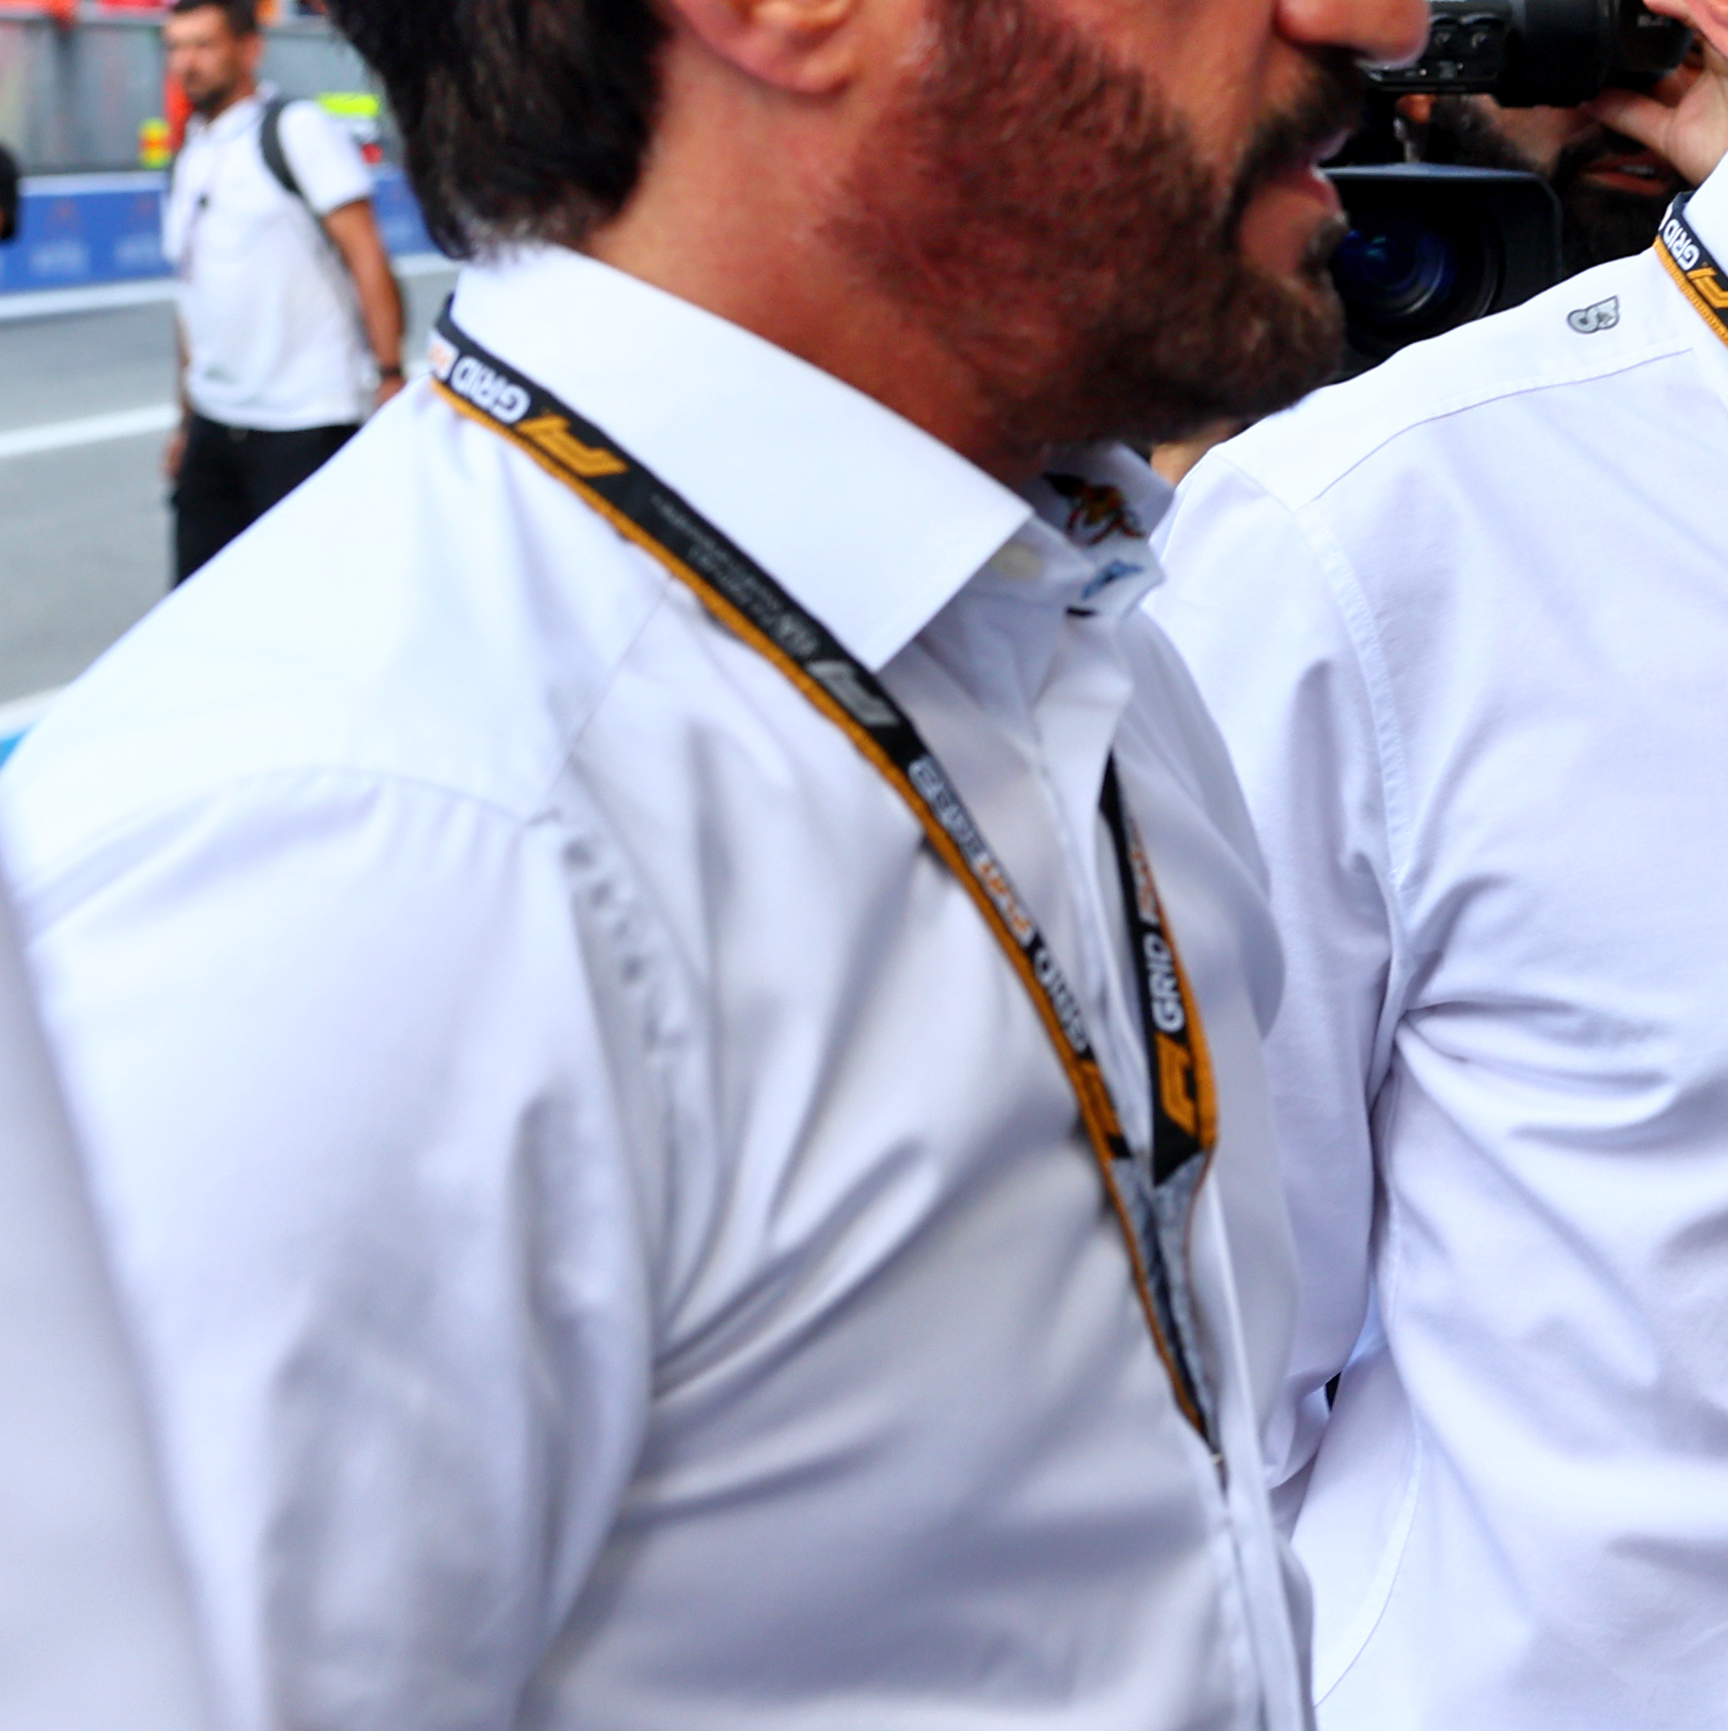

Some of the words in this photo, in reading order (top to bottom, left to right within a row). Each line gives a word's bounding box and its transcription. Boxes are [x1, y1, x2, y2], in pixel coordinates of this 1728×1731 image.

[1663, 219, 1701, 271] GRID
[450, 355, 532, 424] GRID
[1143, 932, 1187, 1033] GRID
